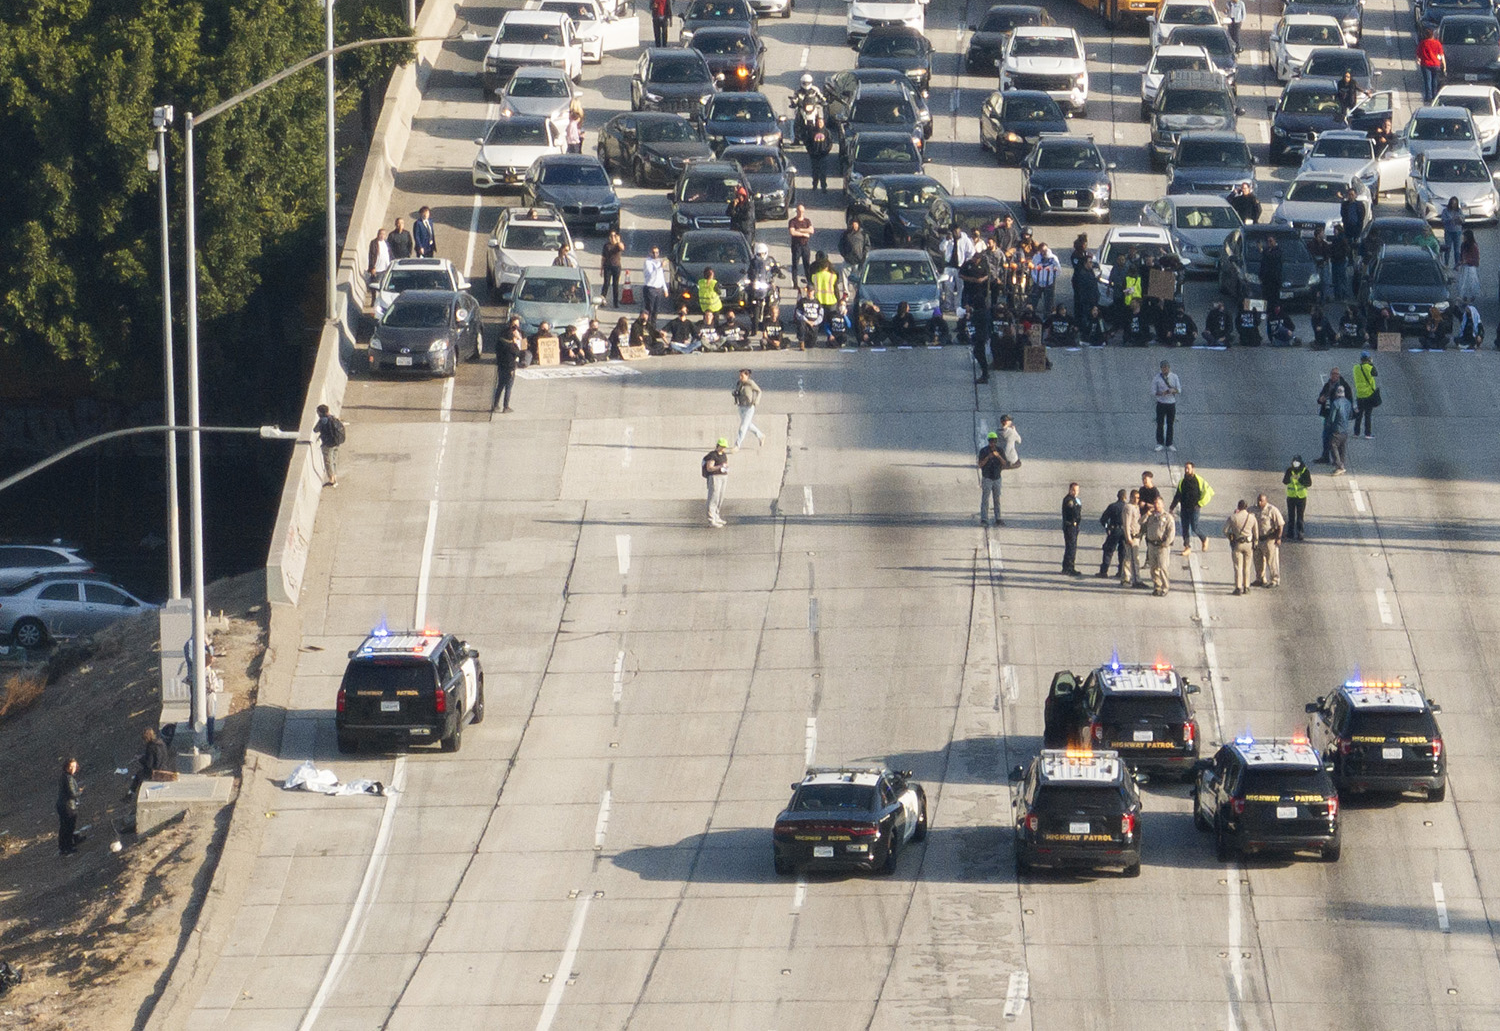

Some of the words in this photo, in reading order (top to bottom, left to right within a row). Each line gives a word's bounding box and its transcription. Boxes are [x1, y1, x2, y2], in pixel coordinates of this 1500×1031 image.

[1350, 736, 1386, 744] HIGHWAY
[1400, 736, 1428, 744] PATROL
[1111, 741, 1145, 749] HIGHWAY
[1146, 741, 1175, 749] PATROL
[1245, 794, 1281, 802] HIGHWAY
[1295, 794, 1324, 802] PATROL
